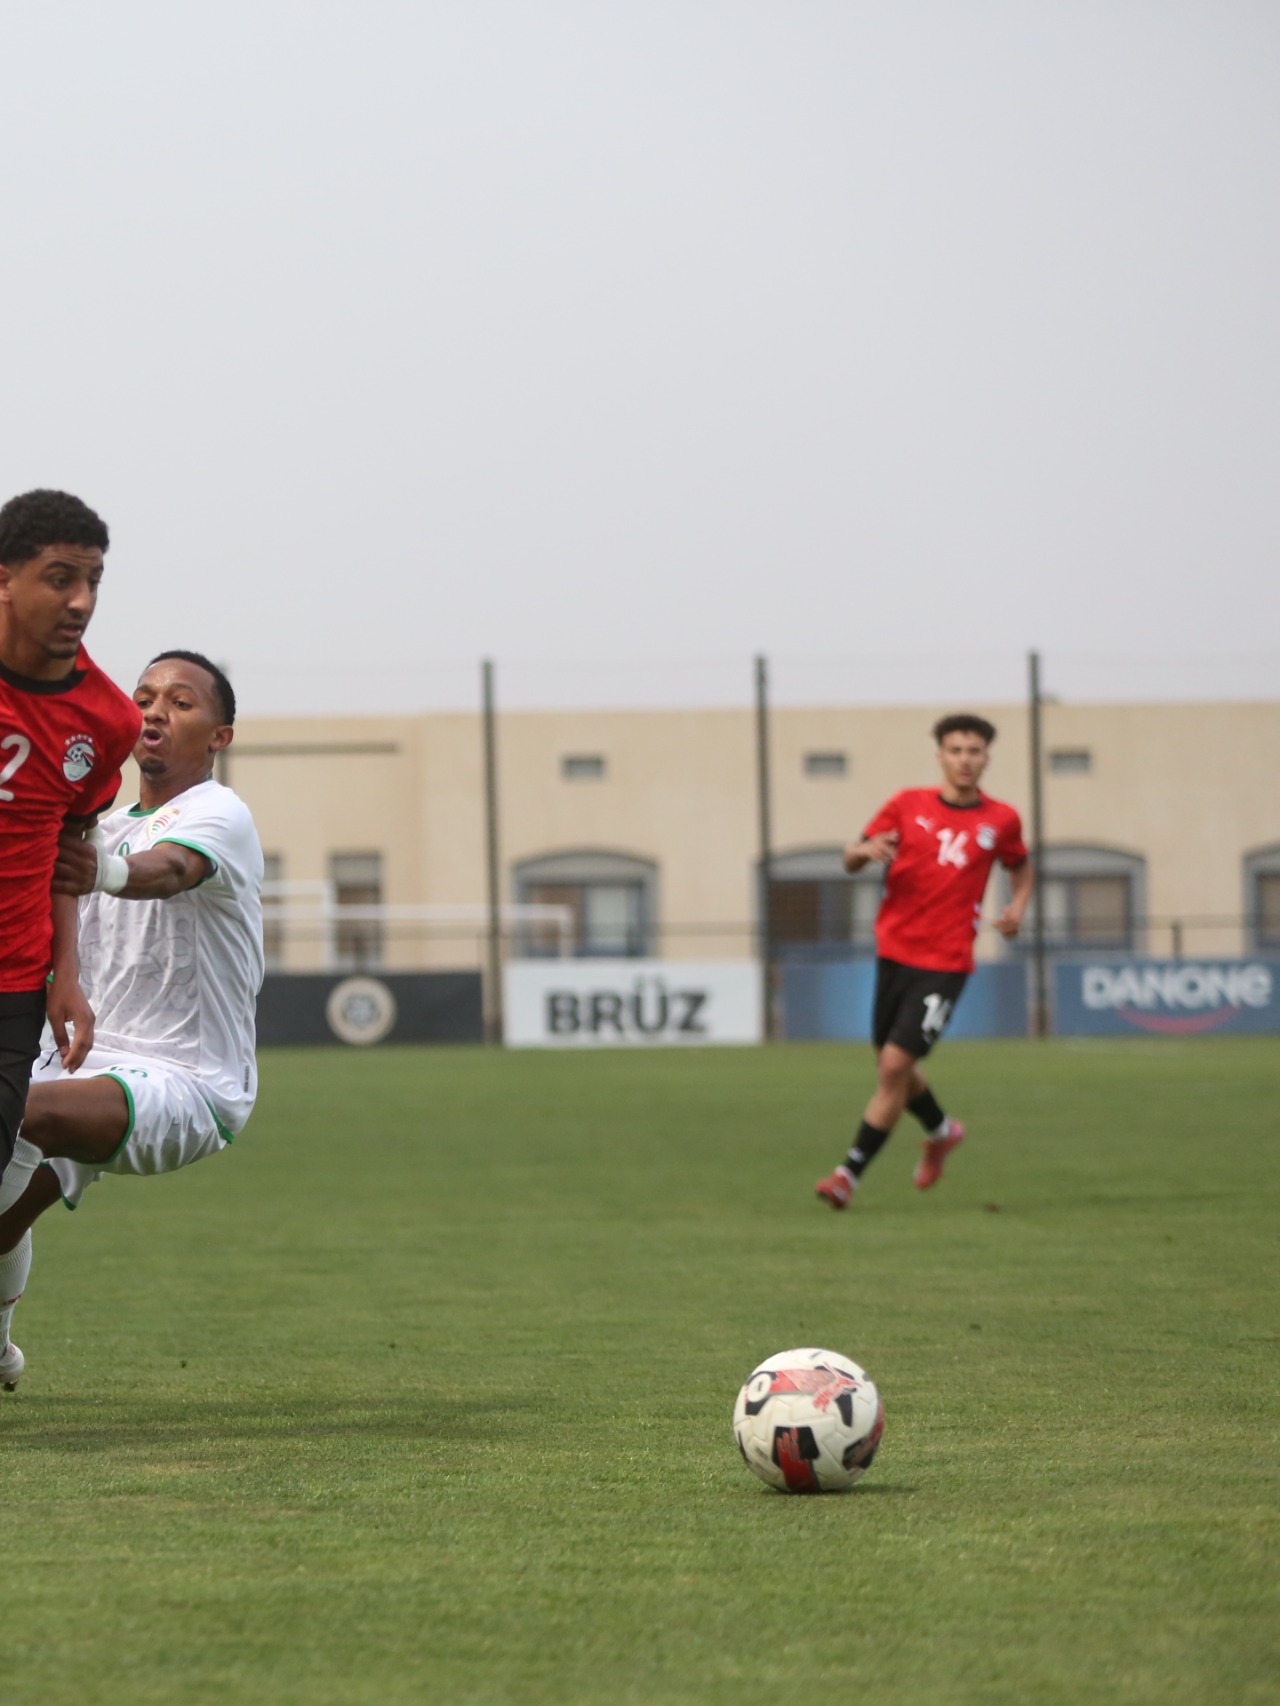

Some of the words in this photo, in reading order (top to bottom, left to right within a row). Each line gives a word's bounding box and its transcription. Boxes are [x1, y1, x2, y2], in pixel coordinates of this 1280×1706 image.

[936, 828, 969, 870] 14
[547, 975, 708, 1034] BRÜZ
[1083, 966, 1272, 1010] DANONE
